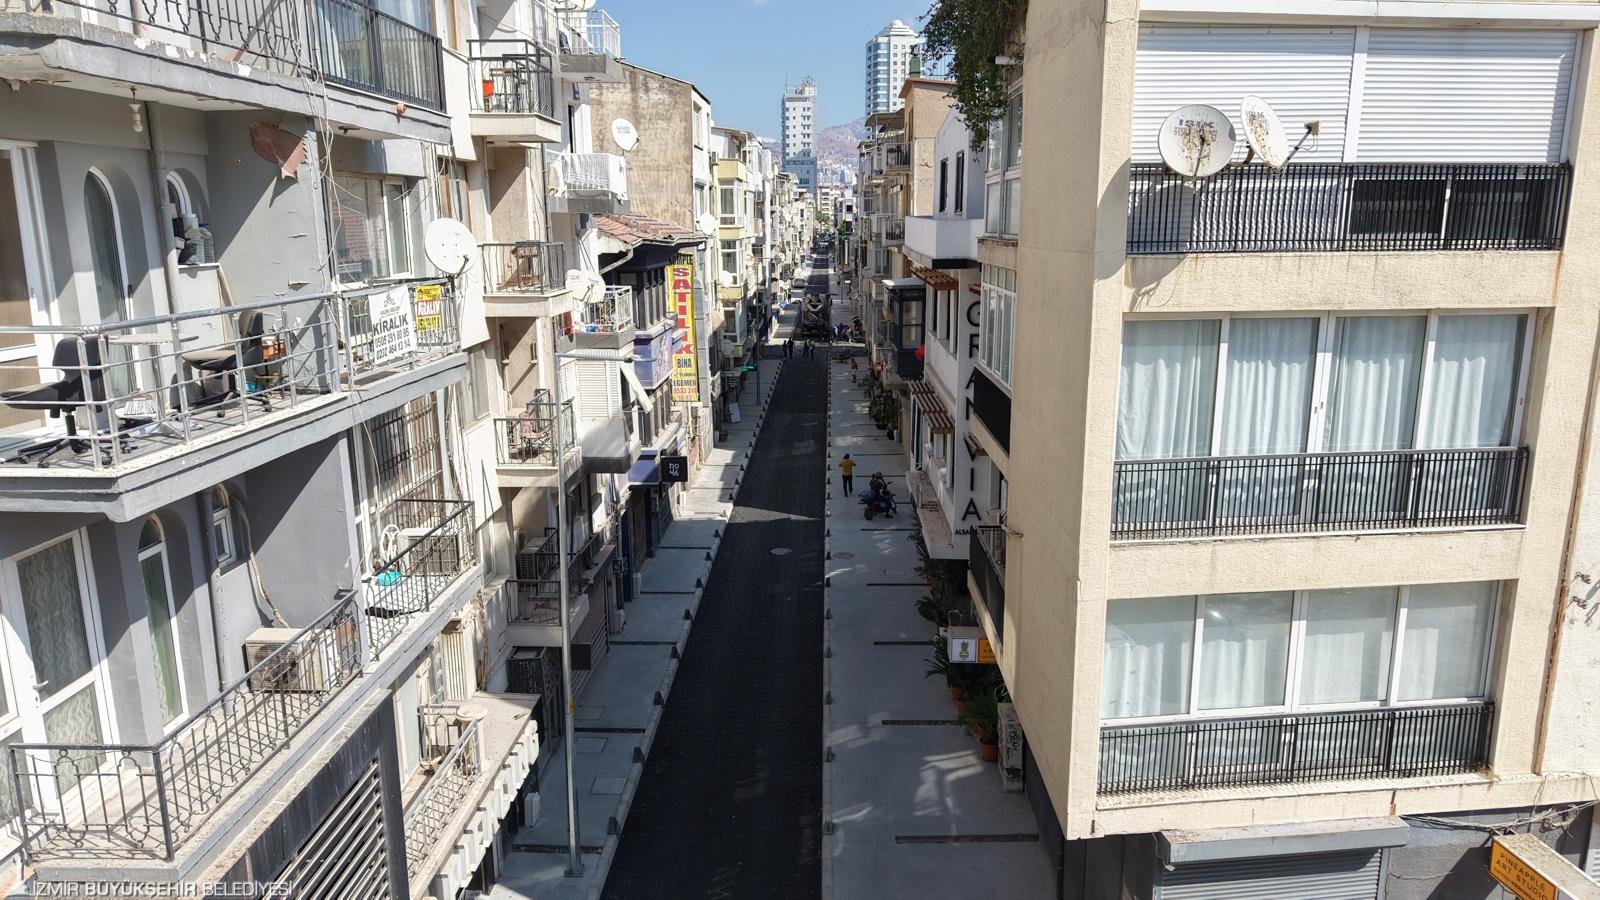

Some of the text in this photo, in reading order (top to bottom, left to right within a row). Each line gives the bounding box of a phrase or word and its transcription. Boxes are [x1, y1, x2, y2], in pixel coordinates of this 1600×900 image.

[373, 313, 409, 337] KİRALIK
[1496, 860, 1512, 874] ART
[1516, 873, 1547, 900] STUDIO
[1499, 852, 1546, 892] PINEAPPLE
